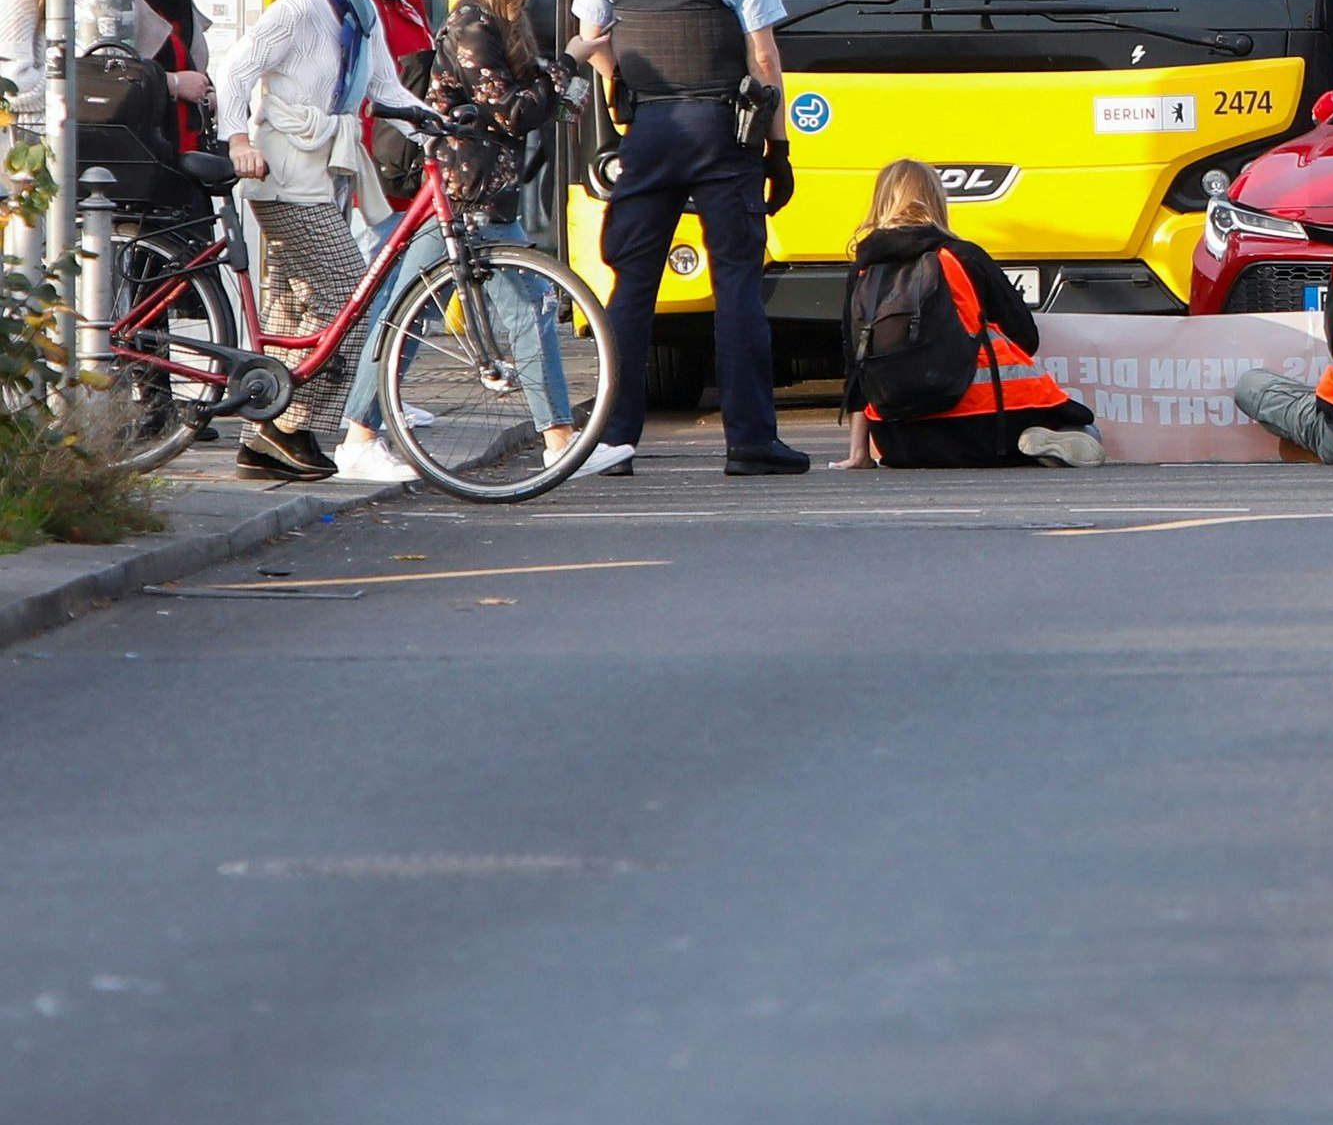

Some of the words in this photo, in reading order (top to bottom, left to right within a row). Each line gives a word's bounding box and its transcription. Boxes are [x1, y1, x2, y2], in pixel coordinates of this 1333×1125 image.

[1103, 107, 1156, 122] BERLIN
[1213, 89, 1273, 116] 2474
[934, 168, 994, 191] DL
